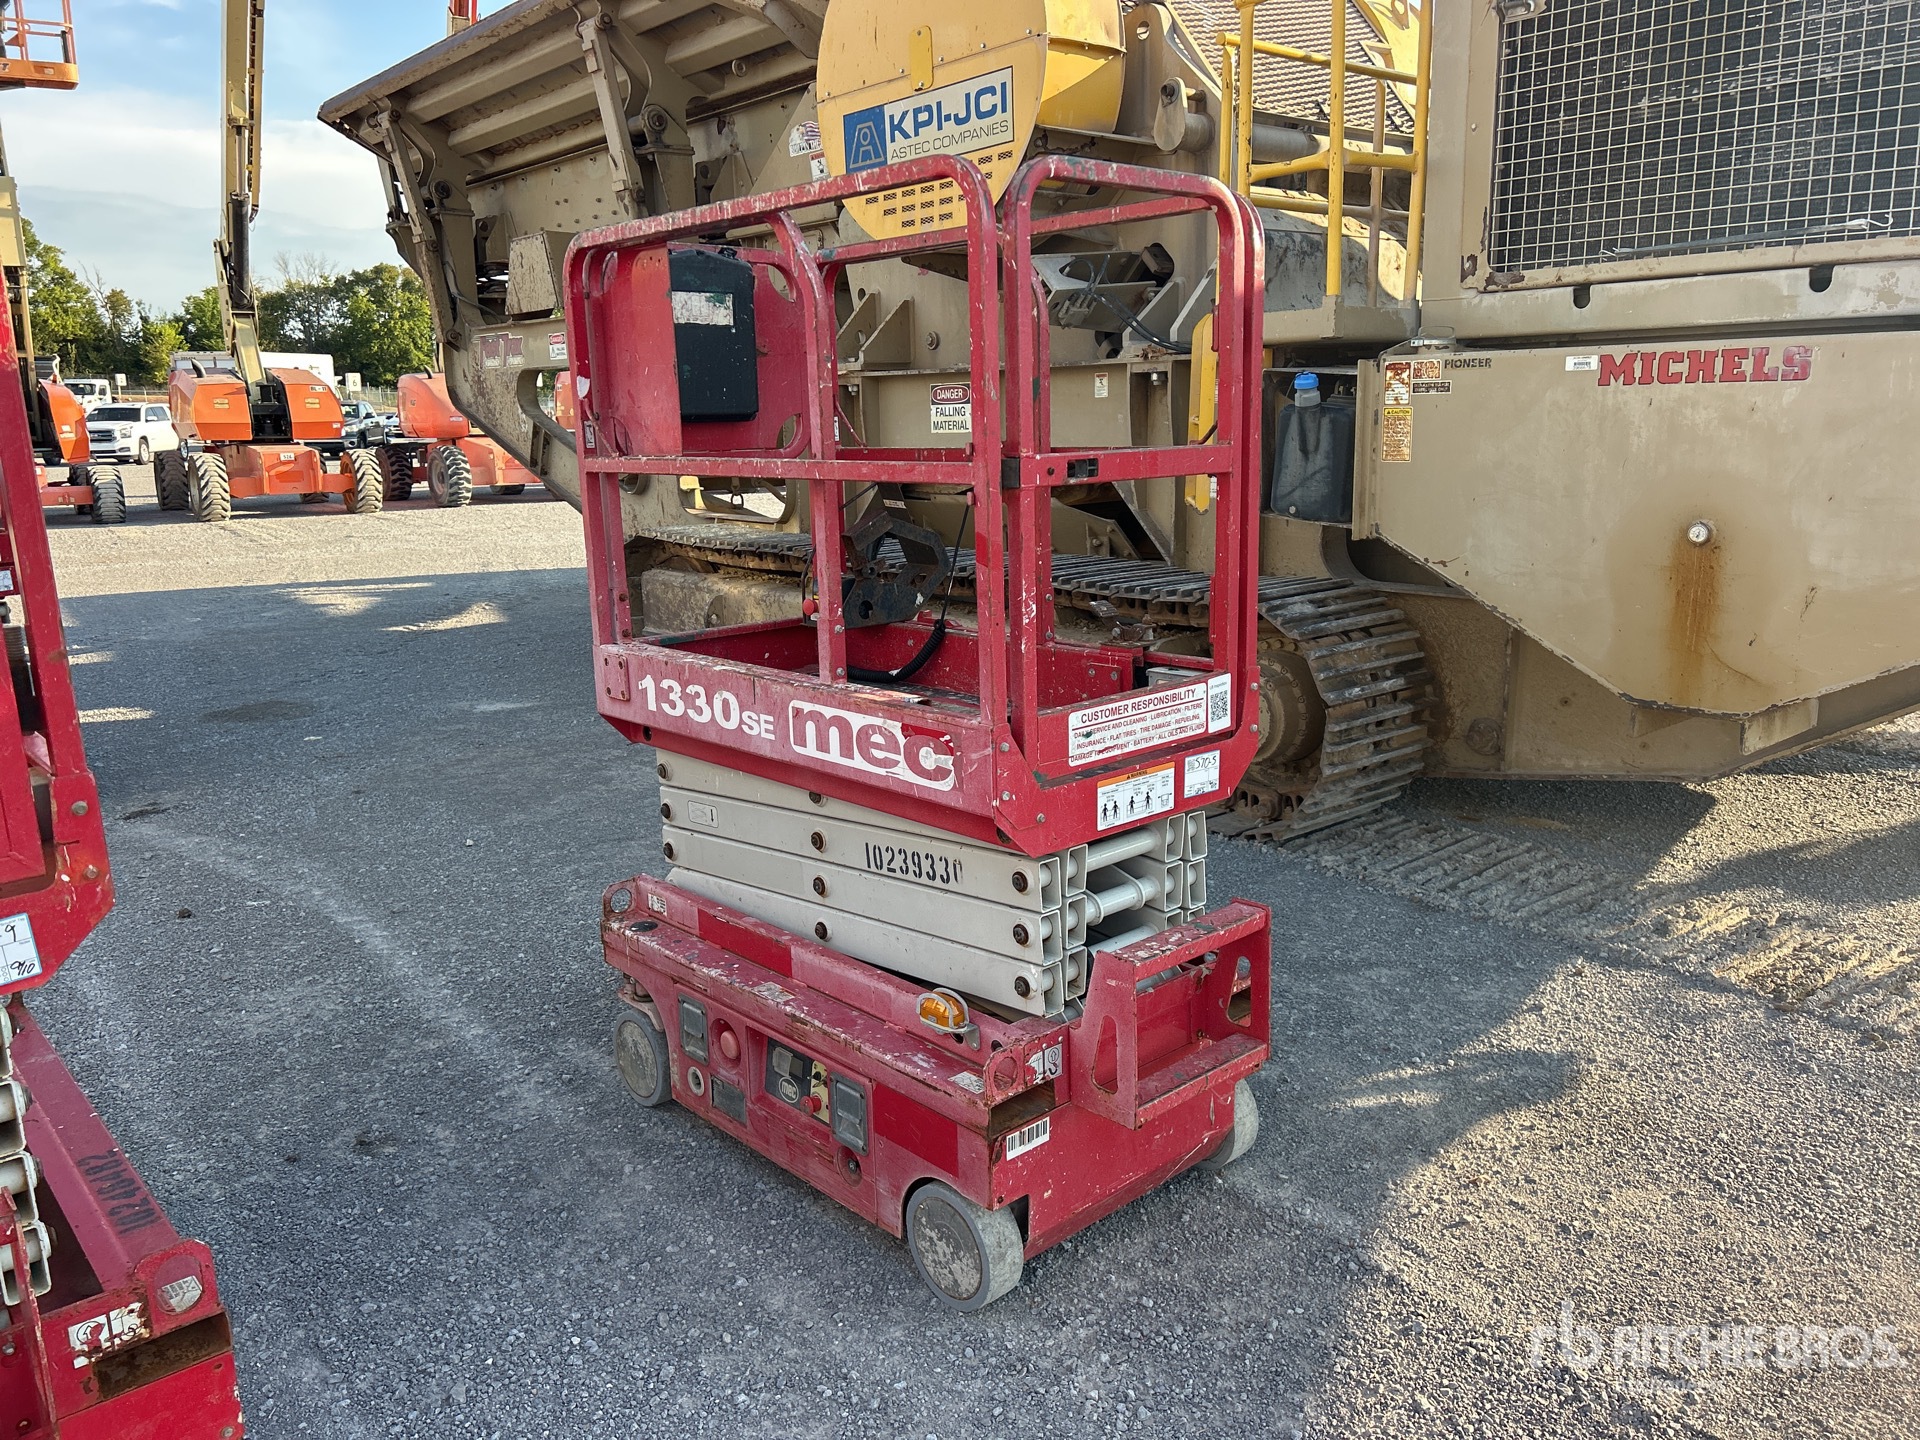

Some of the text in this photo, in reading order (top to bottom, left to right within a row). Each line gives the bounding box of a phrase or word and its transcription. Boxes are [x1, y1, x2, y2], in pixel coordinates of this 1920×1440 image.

[889, 81, 1008, 144] KPI-JCI
[890, 120, 1008, 160] ASTEC COMPANIES
[1444, 358, 1492, 369] PIONEER
[1598, 345, 1813, 386] MICHELS
[936, 388, 963, 400] DANGER
[936, 406, 966, 417] FALLING
[933, 419, 969, 430] MATERIAL
[1081, 688, 1196, 723] CUSTOMER RESPONSIBILITY
[1090, 725, 1111, 734] SERVICE
[1111, 721, 1122, 729] AND
[1123, 716, 1147, 727] CLEANING
[1150, 708, 1181, 720] LUBRICATION
[1184, 702, 1202, 712] FILTERS
[1071, 751, 1093, 763] DAMAGE
[1134, 736, 1155, 747] BATTERY
[1168, 728, 1179, 737] OILS
[1179, 726, 1188, 735] AND
[1188, 722, 1205, 732] FLUIDS
[1076, 714, 1199, 749] INSURANCE FLAT TIRES TIRE DAMAGE REFUELING
[865, 842, 963, 884] 10239330
